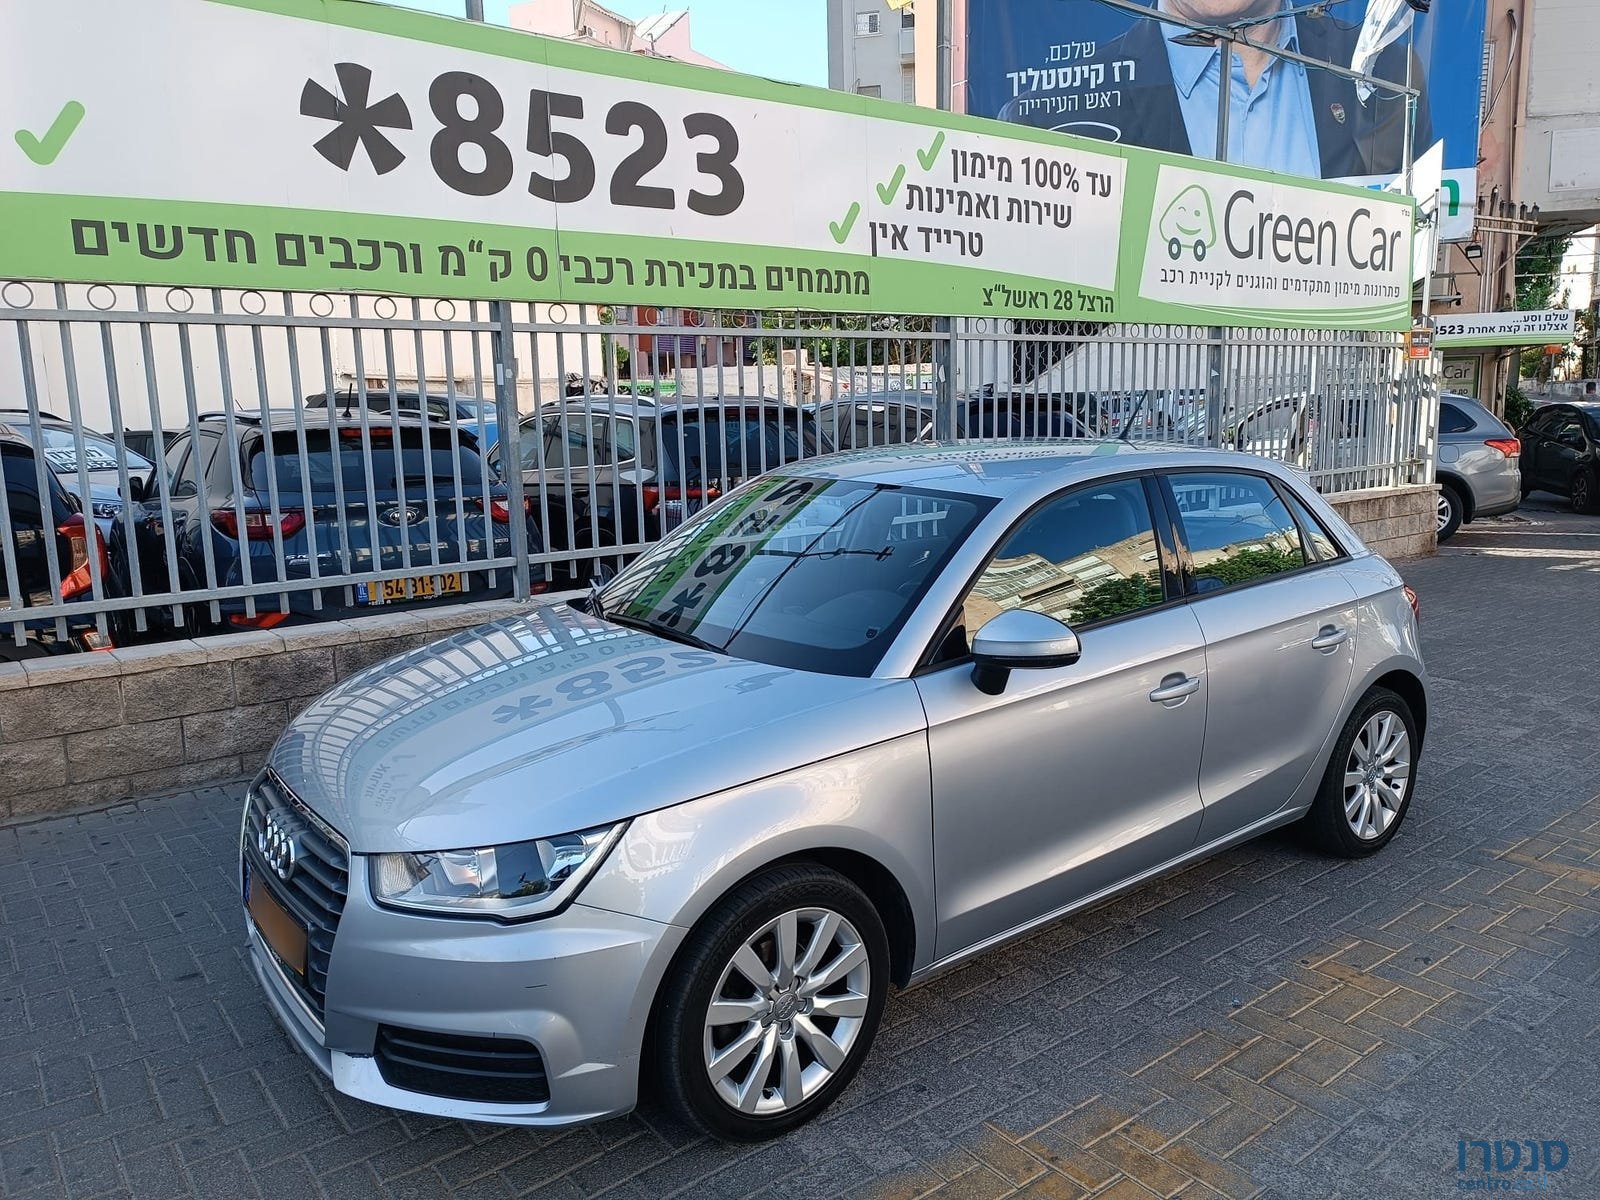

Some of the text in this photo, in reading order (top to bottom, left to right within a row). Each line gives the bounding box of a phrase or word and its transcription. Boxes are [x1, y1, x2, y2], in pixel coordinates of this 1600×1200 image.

[1006, 60, 1136, 97] רז קינסטליך
[1019, 90, 1121, 116] ראש העירייה
[951, 149, 1112, 198] עד 100% מימון
[906, 183, 1073, 229] שירות ואמינות
[70, 218, 258, 265] חדשים
[869, 221, 984, 258] טרייד אין
[1224, 190, 1402, 273] Green Car
[275, 232, 423, 274] ורכבים
[559, 255, 635, 285] רכבי
[645, 259, 758, 292] במכירת
[766, 264, 871, 296] מתמחים
[1160, 267, 1401, 299] פתרונות מימון מתקדמים והוגנים לקניית רכב
[1053, 289, 1073, 312] 28
[1077, 290, 1114, 314] הרצל
[1545, 311, 1569, 322] שלם
[1467, 326, 1496, 335] אחרת
[1498, 323, 1521, 334] קצת
[1523, 323, 1536, 332] זה
[1442, 364, 1471, 379] Car
